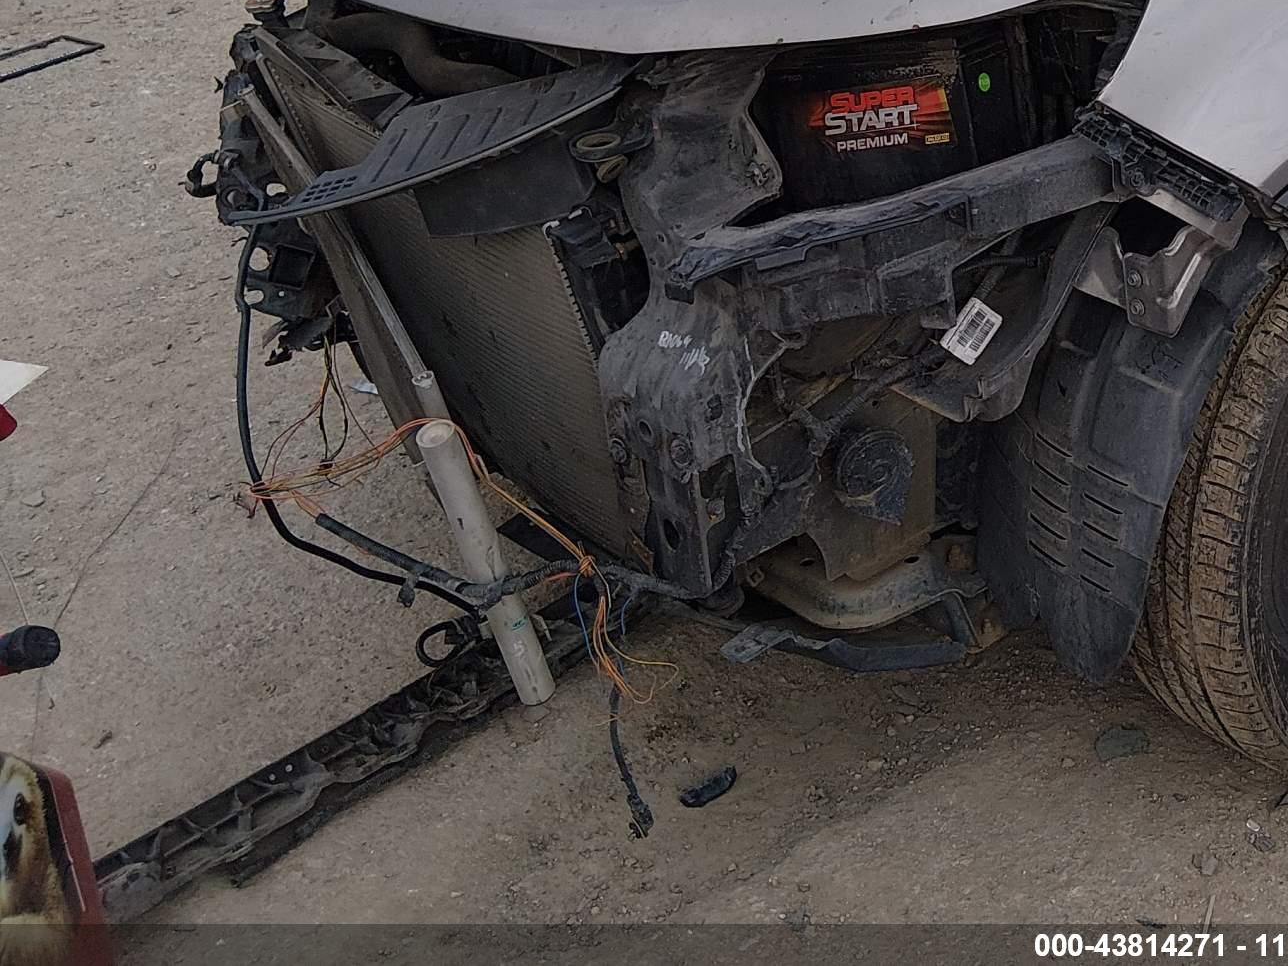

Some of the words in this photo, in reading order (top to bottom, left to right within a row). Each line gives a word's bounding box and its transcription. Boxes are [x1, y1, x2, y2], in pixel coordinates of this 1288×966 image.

[830, 85, 915, 114] SUPER
[824, 104, 918, 136] START
[836, 132, 909, 153] PREMIUM
